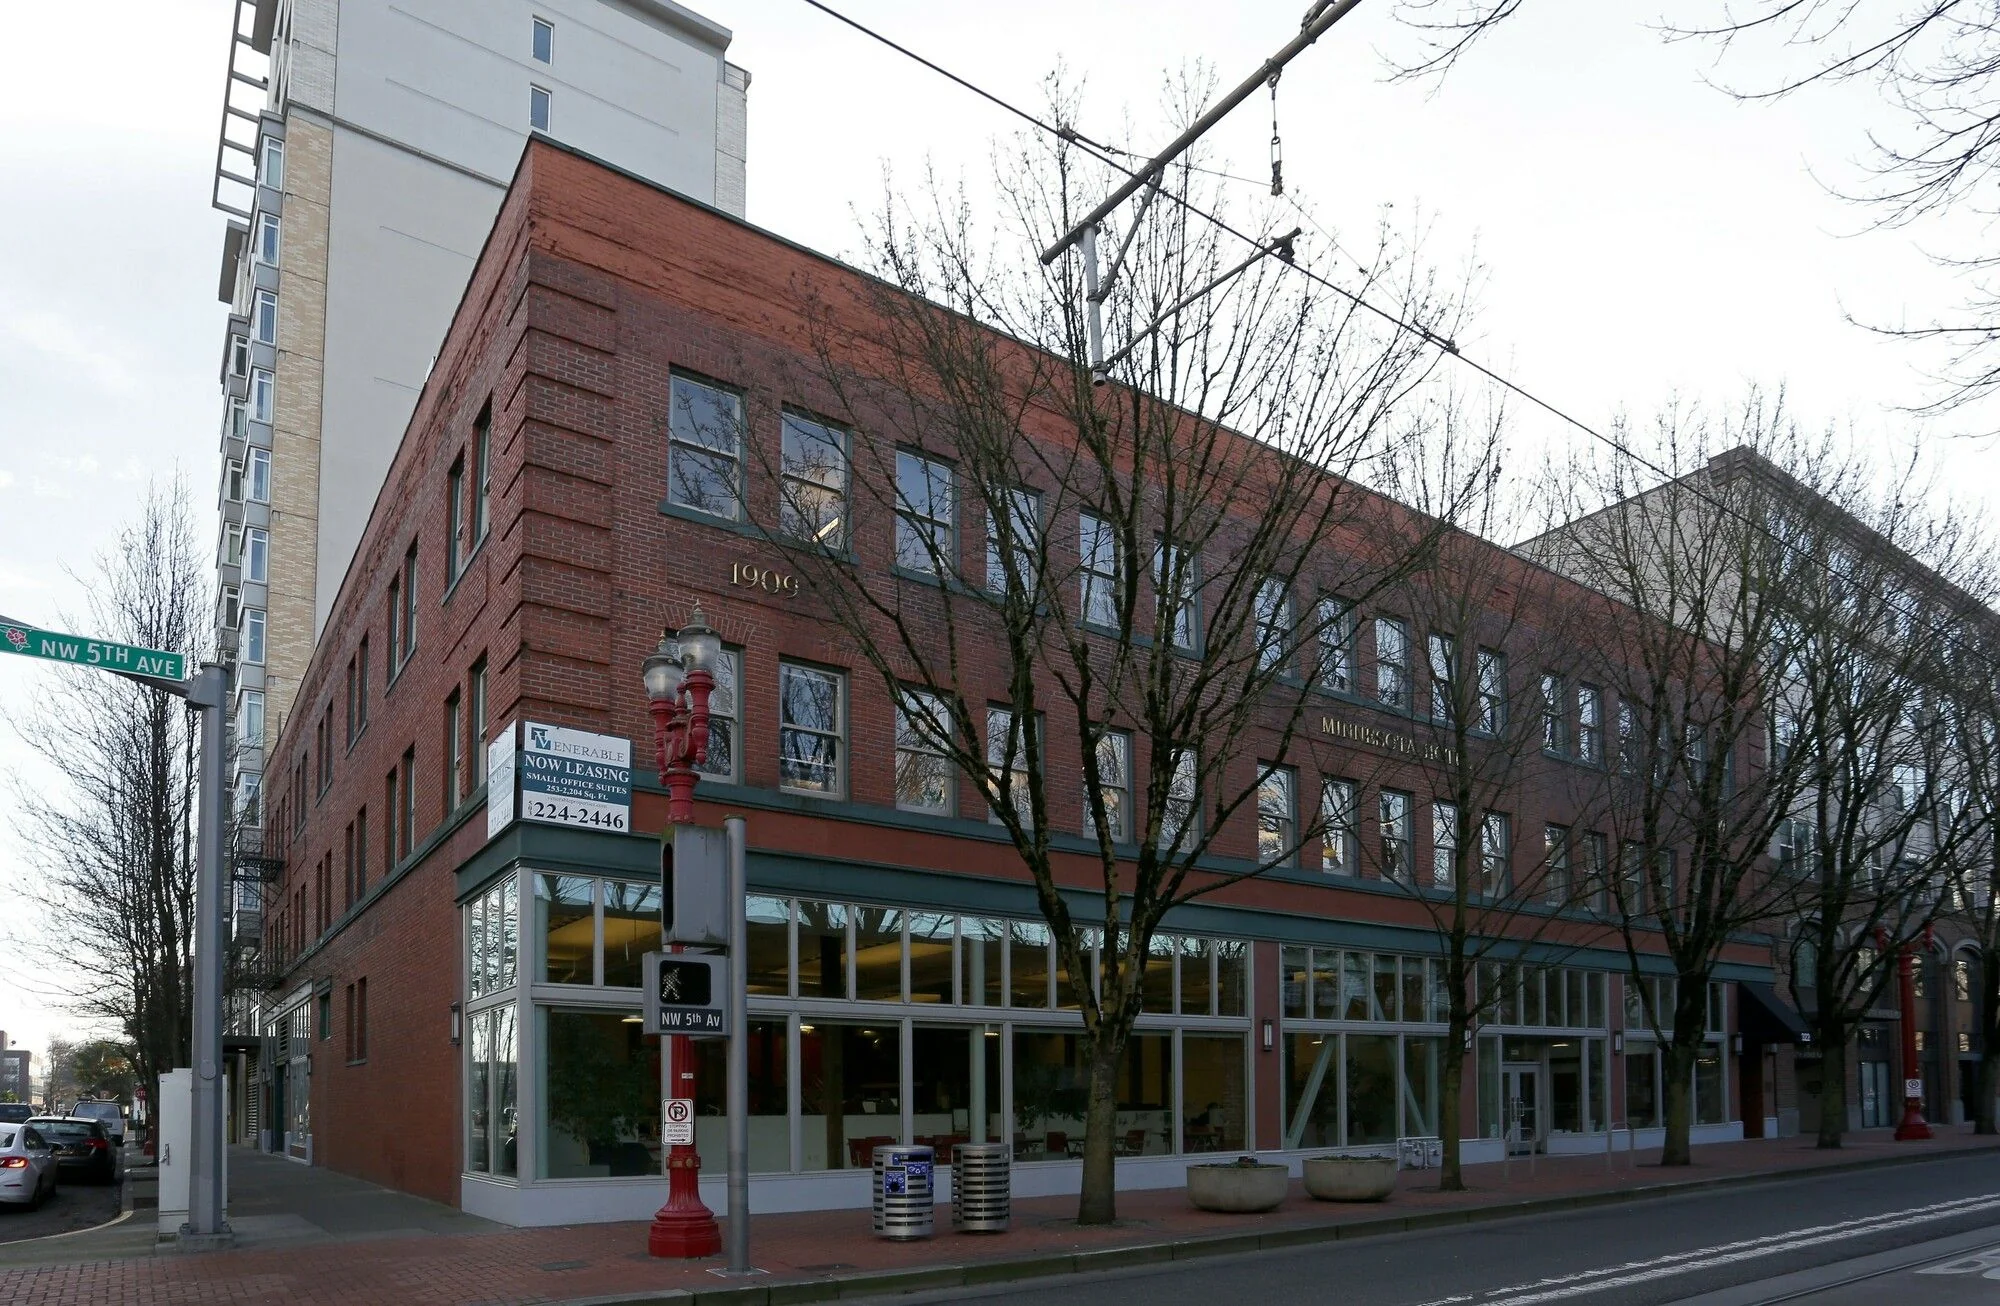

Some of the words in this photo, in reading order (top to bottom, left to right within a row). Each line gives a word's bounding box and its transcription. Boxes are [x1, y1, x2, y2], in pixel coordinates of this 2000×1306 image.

[730, 562, 799, 599] 1909
[41, 639, 79, 660] NW
[87, 642, 129, 664] 5TH
[136, 656, 176, 676] AVE
[525, 755, 562, 772] NOW
[566, 761, 630, 783] LEASING
[526, 772, 560, 784] SMALL
[561, 778, 594, 790] OFFICE
[596, 783, 627, 795] SUITES
[534, 802, 624, 829] 224-2446
[662, 1012, 681, 1026] NW
[686, 1013, 702, 1026] 5th
[706, 1013, 720, 1027] Av
